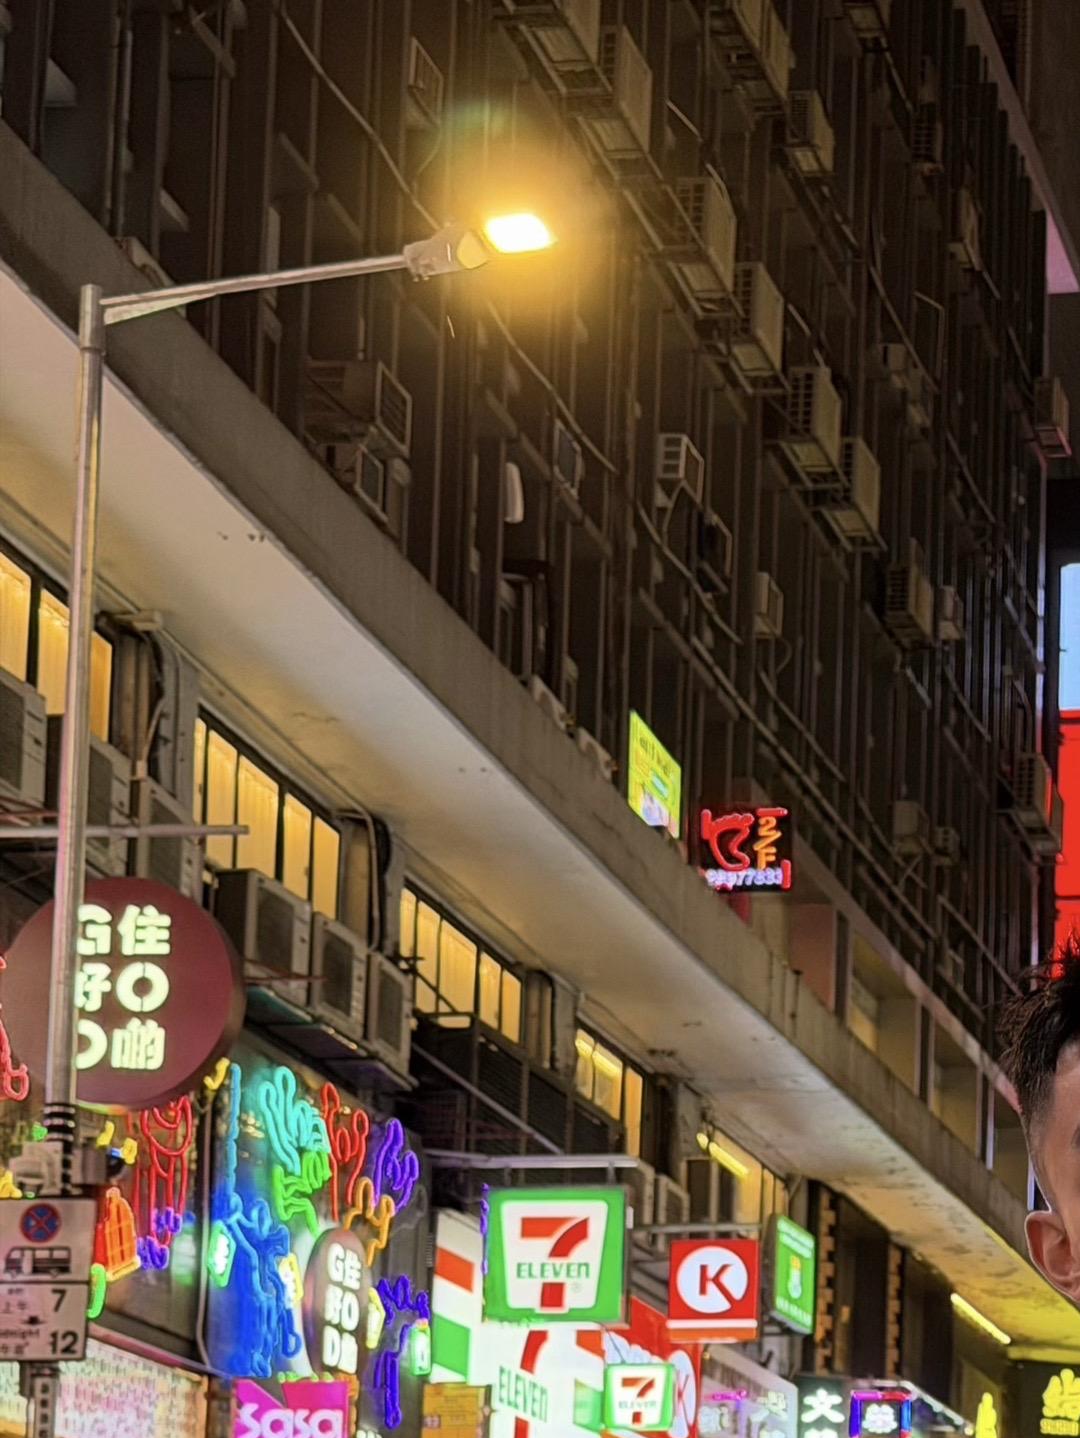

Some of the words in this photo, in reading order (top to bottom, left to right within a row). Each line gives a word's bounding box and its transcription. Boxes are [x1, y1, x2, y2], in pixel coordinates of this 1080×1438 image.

[699, 1263, 738, 1310] K
[51, 1288, 68, 1313] 7
[49, 1329, 79, 1355] 12
